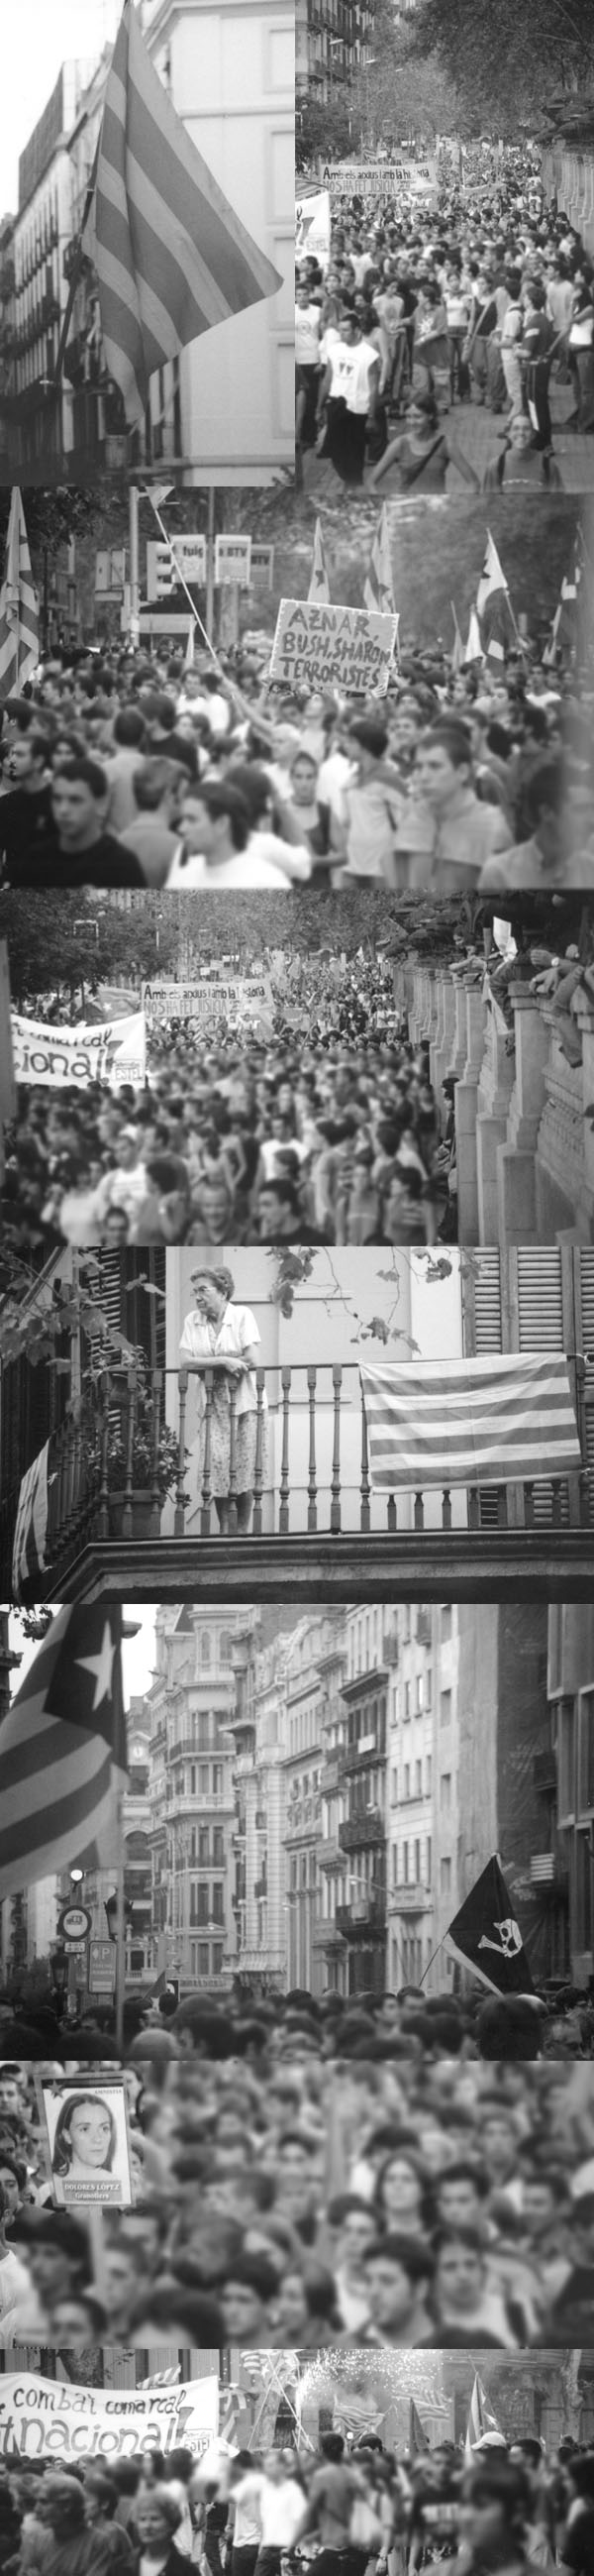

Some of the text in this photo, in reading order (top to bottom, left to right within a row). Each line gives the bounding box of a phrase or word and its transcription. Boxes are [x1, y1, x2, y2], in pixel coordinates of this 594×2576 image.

[278, 656, 381, 690] TERRORISTES
[102, 1947, 111, 1960] P
[105, 2389, 187, 2415] comarcal
